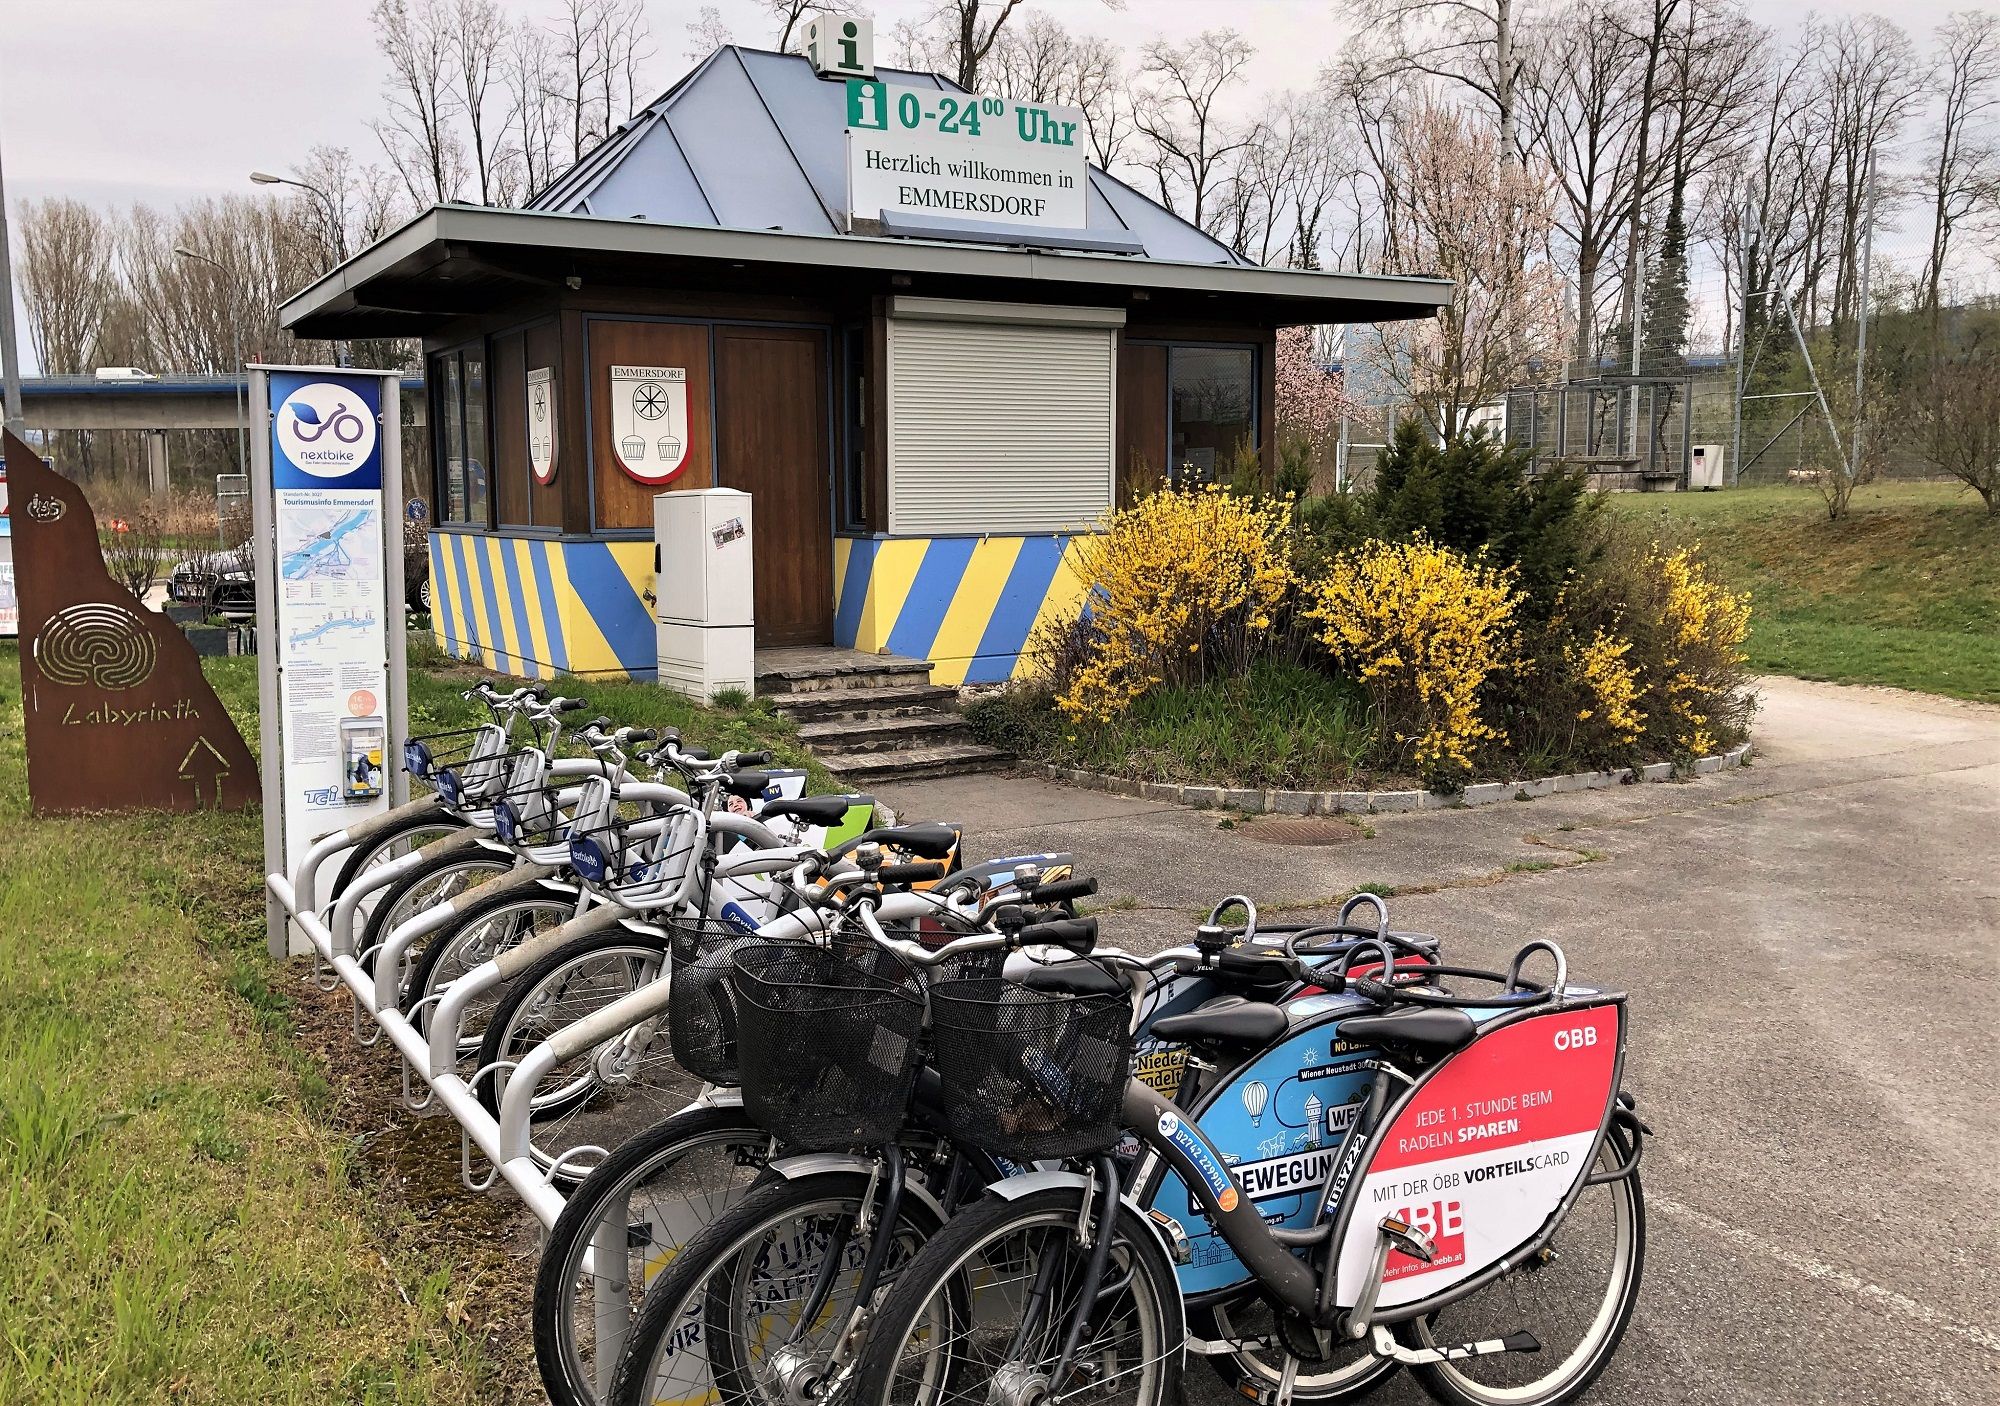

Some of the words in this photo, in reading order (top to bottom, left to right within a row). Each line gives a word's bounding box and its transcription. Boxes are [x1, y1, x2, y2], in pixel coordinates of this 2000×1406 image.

[1015, 106, 1076, 146] Uhr
[866, 149, 941, 175] Herzlich
[948, 160, 1052, 186] willkommen
[1058, 169, 1074, 188] in
[898, 185, 1046, 217] EMMERSDORF
[614, 367, 684, 379] EMMERSDORF
[300, 449, 354, 461] nextbike
[62, 699, 200, 726] Labyrinth
[769, 786, 780, 795] NV
[1335, 1040, 1347, 1052] NÖ
[1554, 1026, 1597, 1051] ÖBB
[1301, 1069, 1325, 1080] Wiener
[1325, 1064, 1357, 1075] Neustadt
[1415, 1108, 1446, 1129] JEDE
[1451, 1106, 1461, 1121] 1.
[1466, 1096, 1518, 1119] STUNDE
[1522, 1089, 1553, 1108] BEIM
[1399, 1131, 1453, 1154] RADELN
[1458, 1118, 1521, 1143] SPAREN:
[1175, 1129, 1202, 1159] 02742
[1198, 1155, 1226, 1194] 229901
[1330, 1136, 1366, 1203] 08722
[1373, 1184, 1398, 1203] MIT
[1402, 1179, 1429, 1197] DER
[1433, 1172, 1460, 1191] ÖBB
[1464, 1150, 1570, 1184] VORTEILSCARD
[1433, 1252, 1462, 1266] oebb.at
